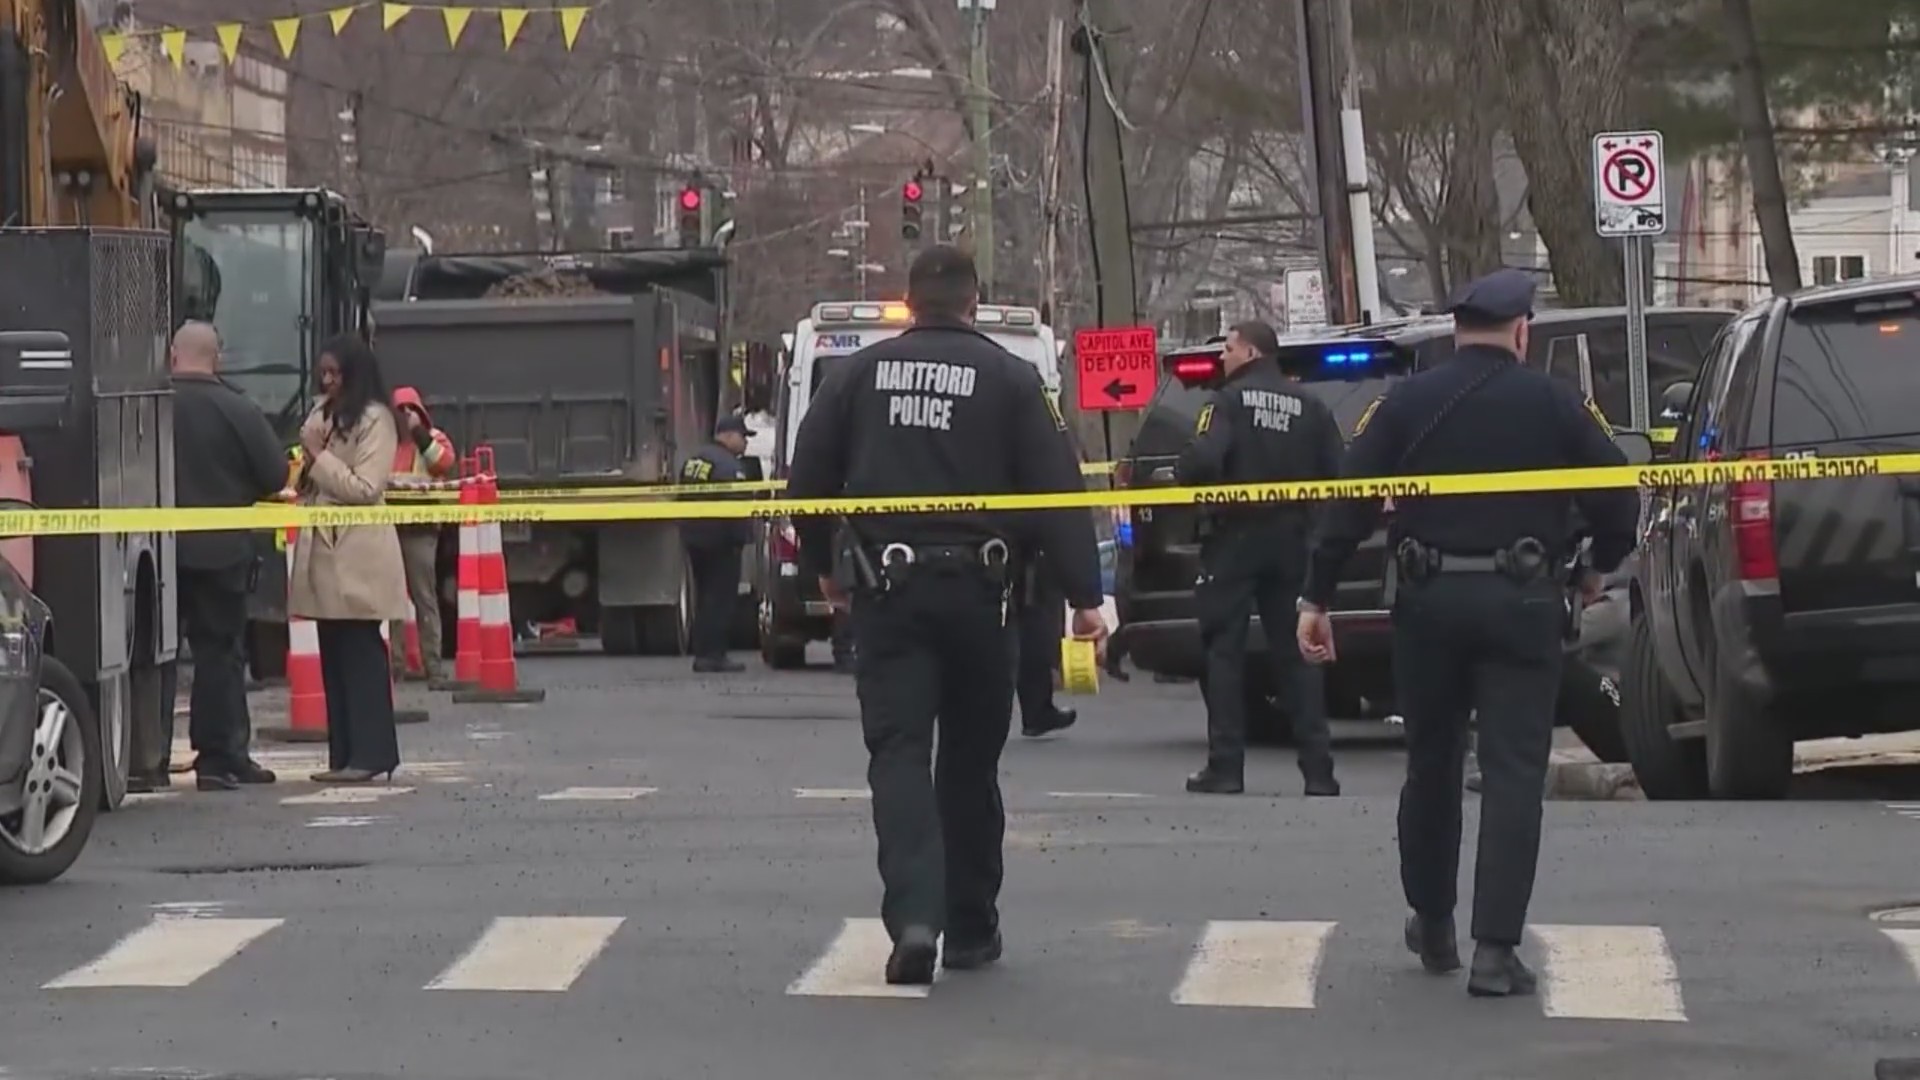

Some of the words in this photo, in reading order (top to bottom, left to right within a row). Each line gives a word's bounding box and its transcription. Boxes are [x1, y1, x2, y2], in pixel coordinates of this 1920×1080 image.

[815, 334, 861, 348] AMR
[1081, 335, 1125, 351] CAPITOL
[1129, 333, 1151, 349] AVE
[1085, 355, 1152, 372] DETOUR
[875, 360, 977, 397] HARTFORD
[1242, 389, 1302, 416] HARTFORD
[889, 395, 954, 431] POLICE
[1253, 408, 1290, 432] POLICE
[1704, 467, 1736, 484] NOT
[1743, 465, 1766, 482] DO
[1772, 462, 1809, 479] LINE
[1817, 459, 1879, 477] POLICE
[1639, 469, 1696, 486] CROSS
[1194, 489, 1250, 504] CROSS
[1258, 488, 1290, 503] NOT
[1297, 487, 1320, 501] DO
[1325, 485, 1363, 499] LINE
[1370, 481, 1431, 498] POLICE
